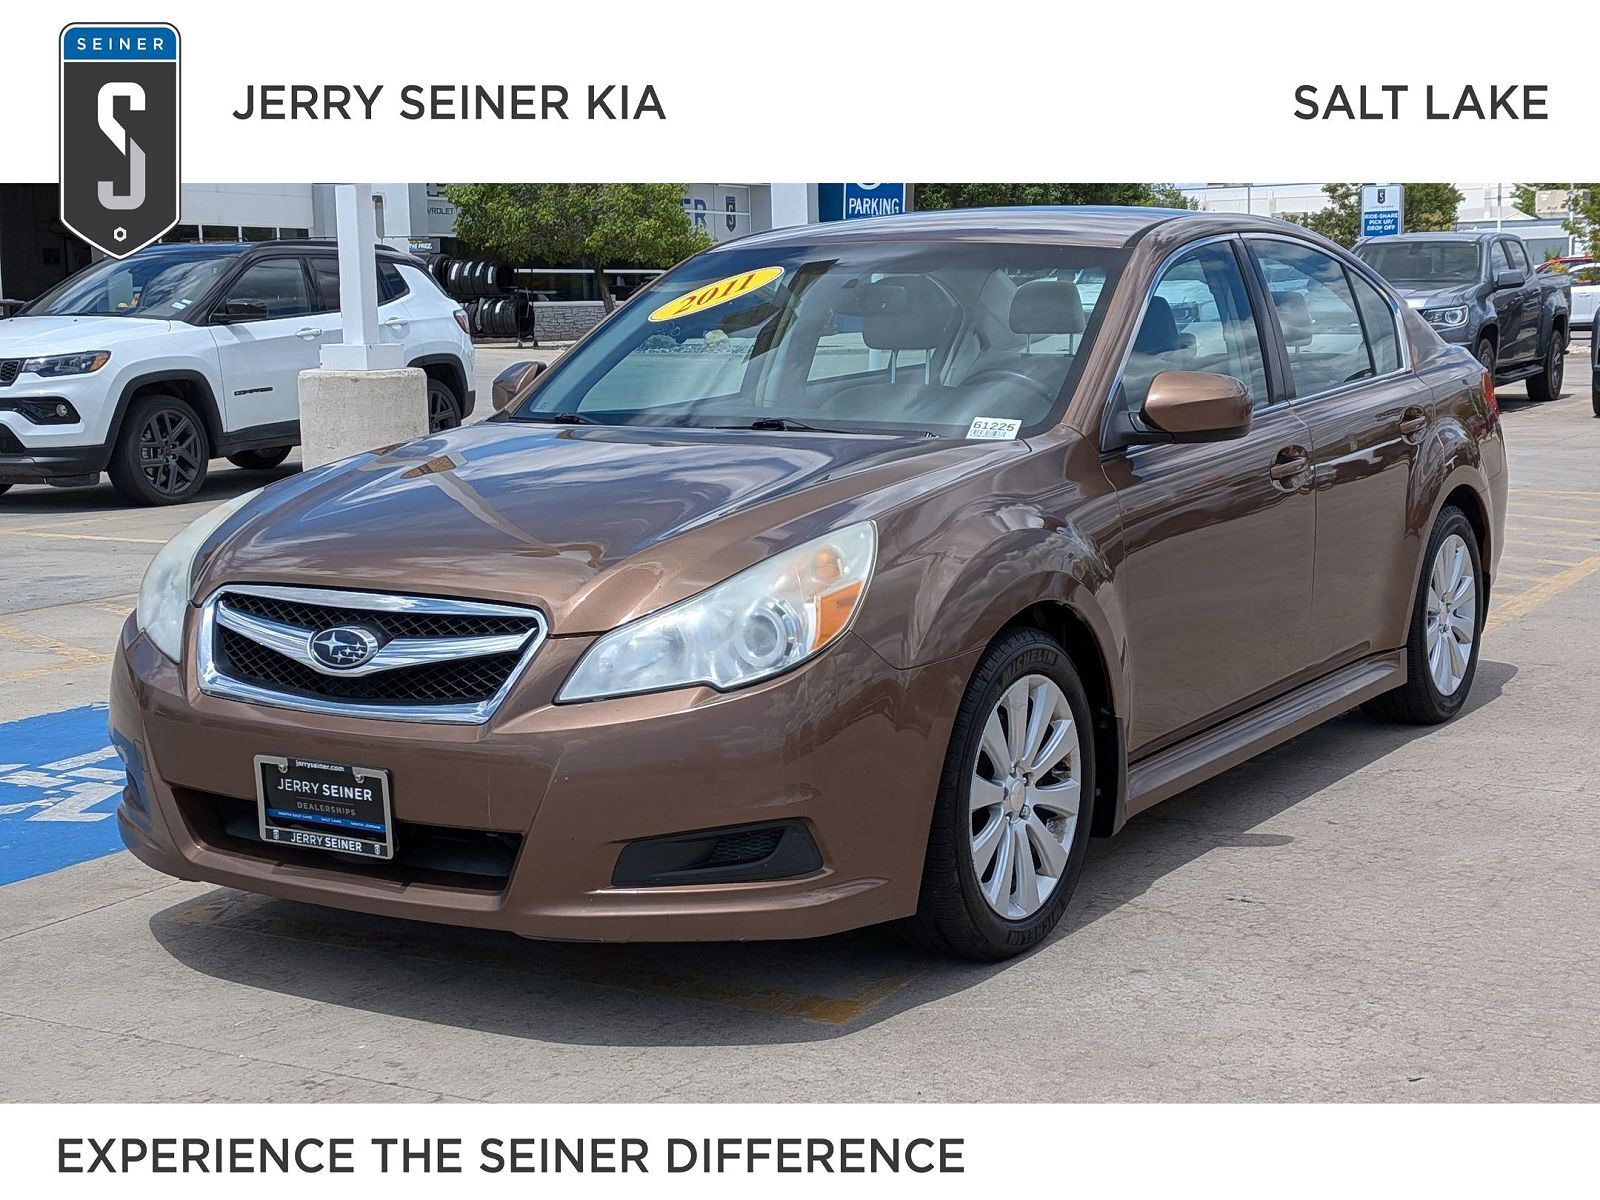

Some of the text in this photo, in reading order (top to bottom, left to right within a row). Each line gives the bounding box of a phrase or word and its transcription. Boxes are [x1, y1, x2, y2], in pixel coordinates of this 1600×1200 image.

[848, 198, 900, 215] PARKING
[672, 272, 757, 316] 2011
[973, 421, 1017, 432] 61225
[1002, 648, 1059, 687] MICHELIN
[296, 760, 344, 772] jerryseiner.com
[277, 778, 373, 801] JERRY SEINER
[296, 802, 357, 816] DEALERSHIPS
[290, 832, 363, 852] JERRY SEINER
